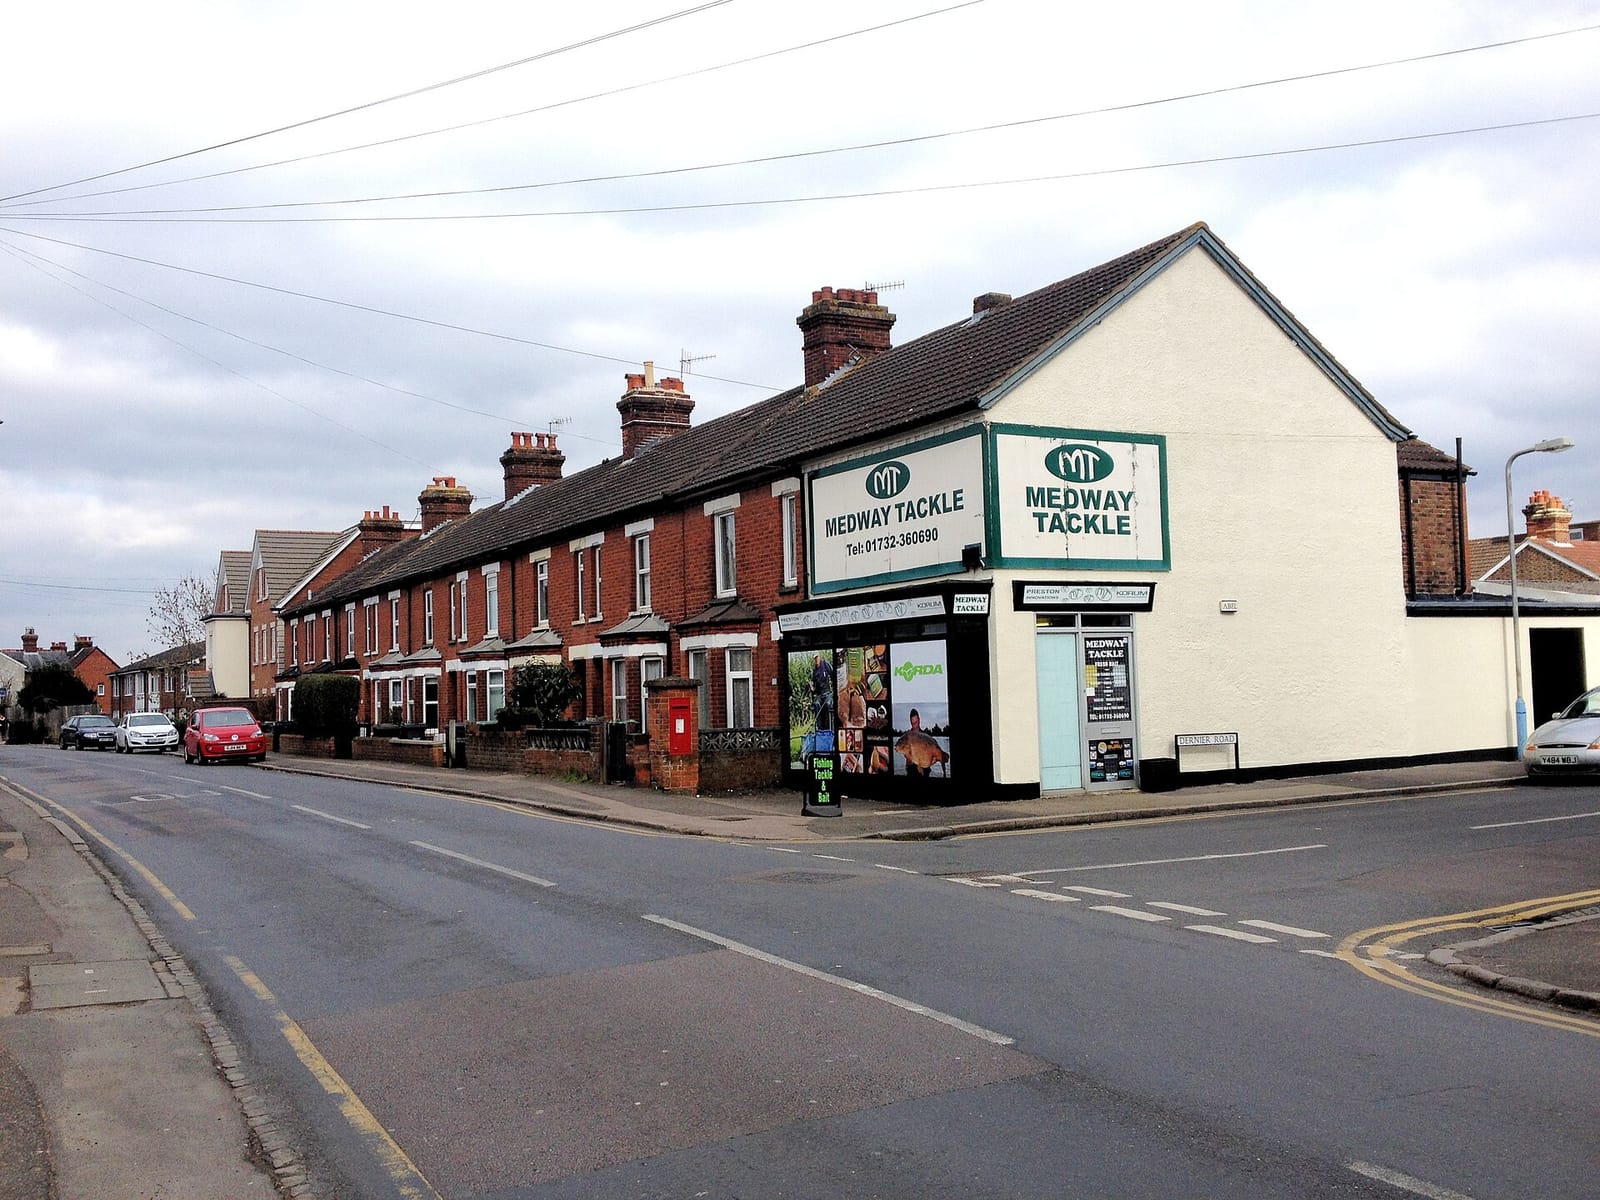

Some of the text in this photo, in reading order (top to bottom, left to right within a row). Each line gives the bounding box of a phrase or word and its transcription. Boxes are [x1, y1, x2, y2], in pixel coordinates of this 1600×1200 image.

[1026, 486, 1133, 511] MEDWAY
[825, 488, 964, 538] MEDWAY TACKLE
[1032, 512, 1131, 535] TACKLE
[846, 527, 939, 557] Tel: 01732-360690
[955, 596, 987, 604] MEDWAY
[1086, 640, 1124, 648] MEDWAY
[1088, 650, 1124, 658] TACKLE
[894, 661, 944, 682] KORDA
[1179, 735, 1234, 744] DERNIER ROAD
[813, 758, 833, 770] Fishing
[815, 770, 833, 779] Tackle
[821, 780, 826, 791] &
[818, 792, 830, 803] Bait
